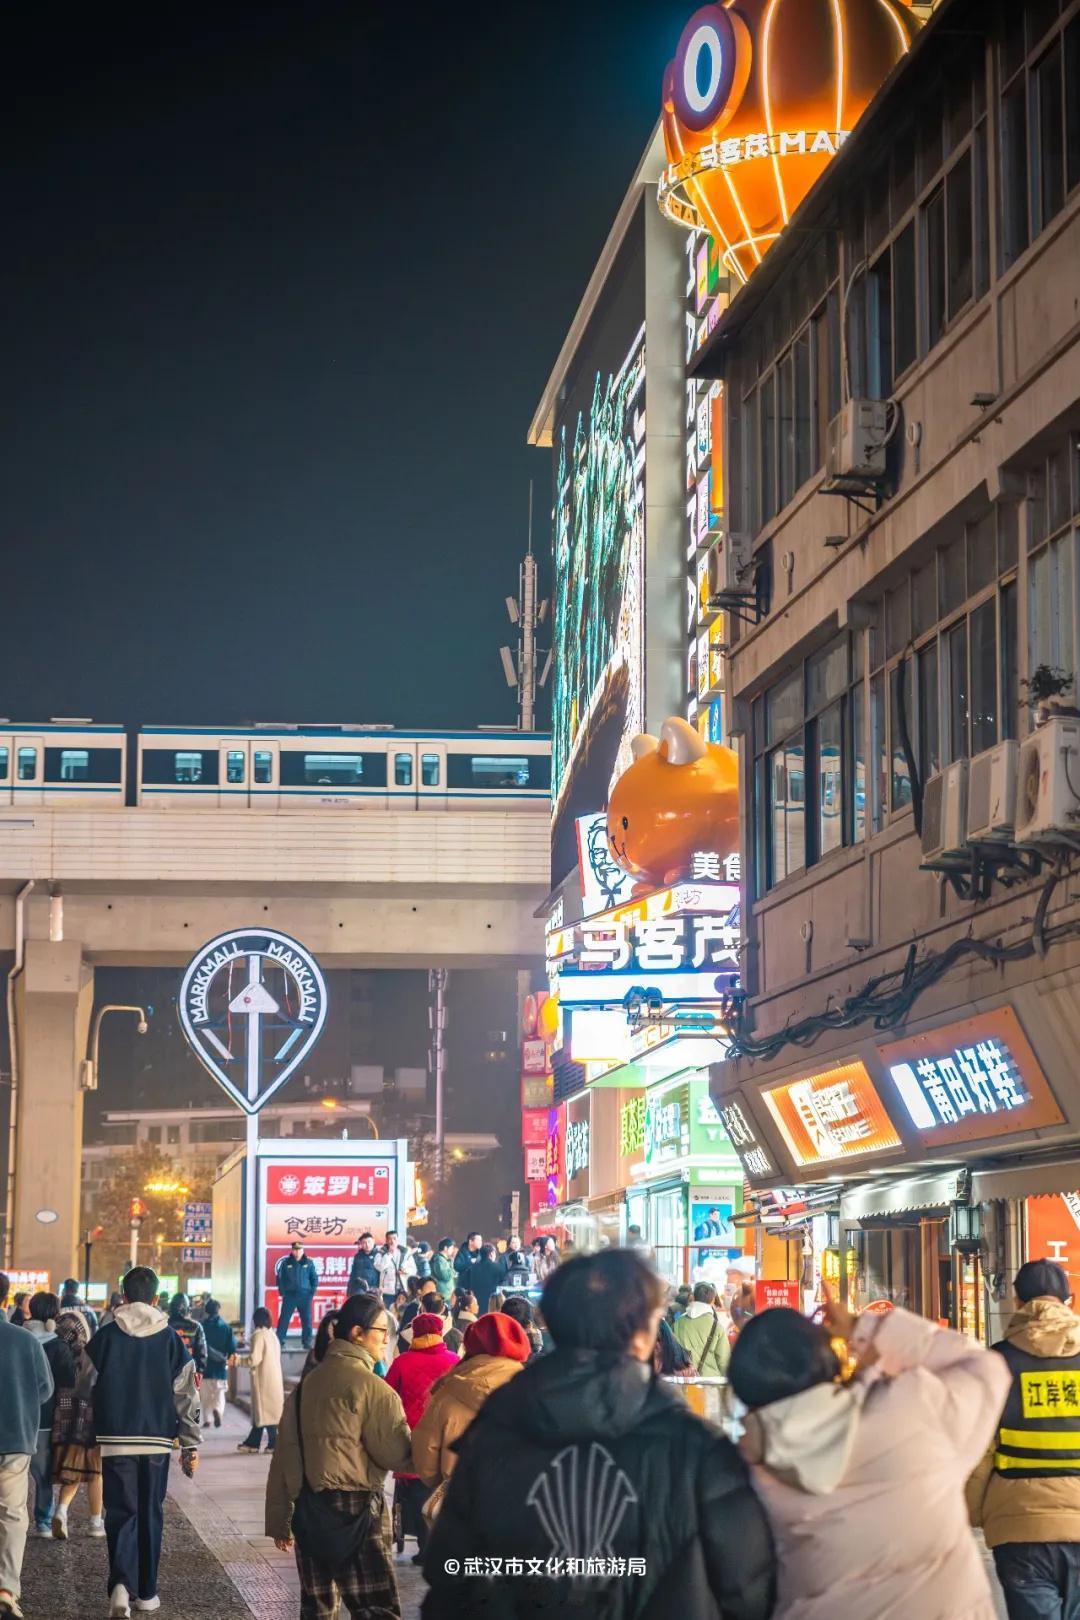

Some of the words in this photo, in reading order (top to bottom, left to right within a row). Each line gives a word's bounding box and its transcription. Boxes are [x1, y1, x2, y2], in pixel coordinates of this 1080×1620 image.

[580, 913, 740, 970] 马客茂
[190, 942, 244, 1024] MARKMALL
[267, 941, 317, 1023] MARKMALL
[302, 1175, 367, 1196] 笨罗卜
